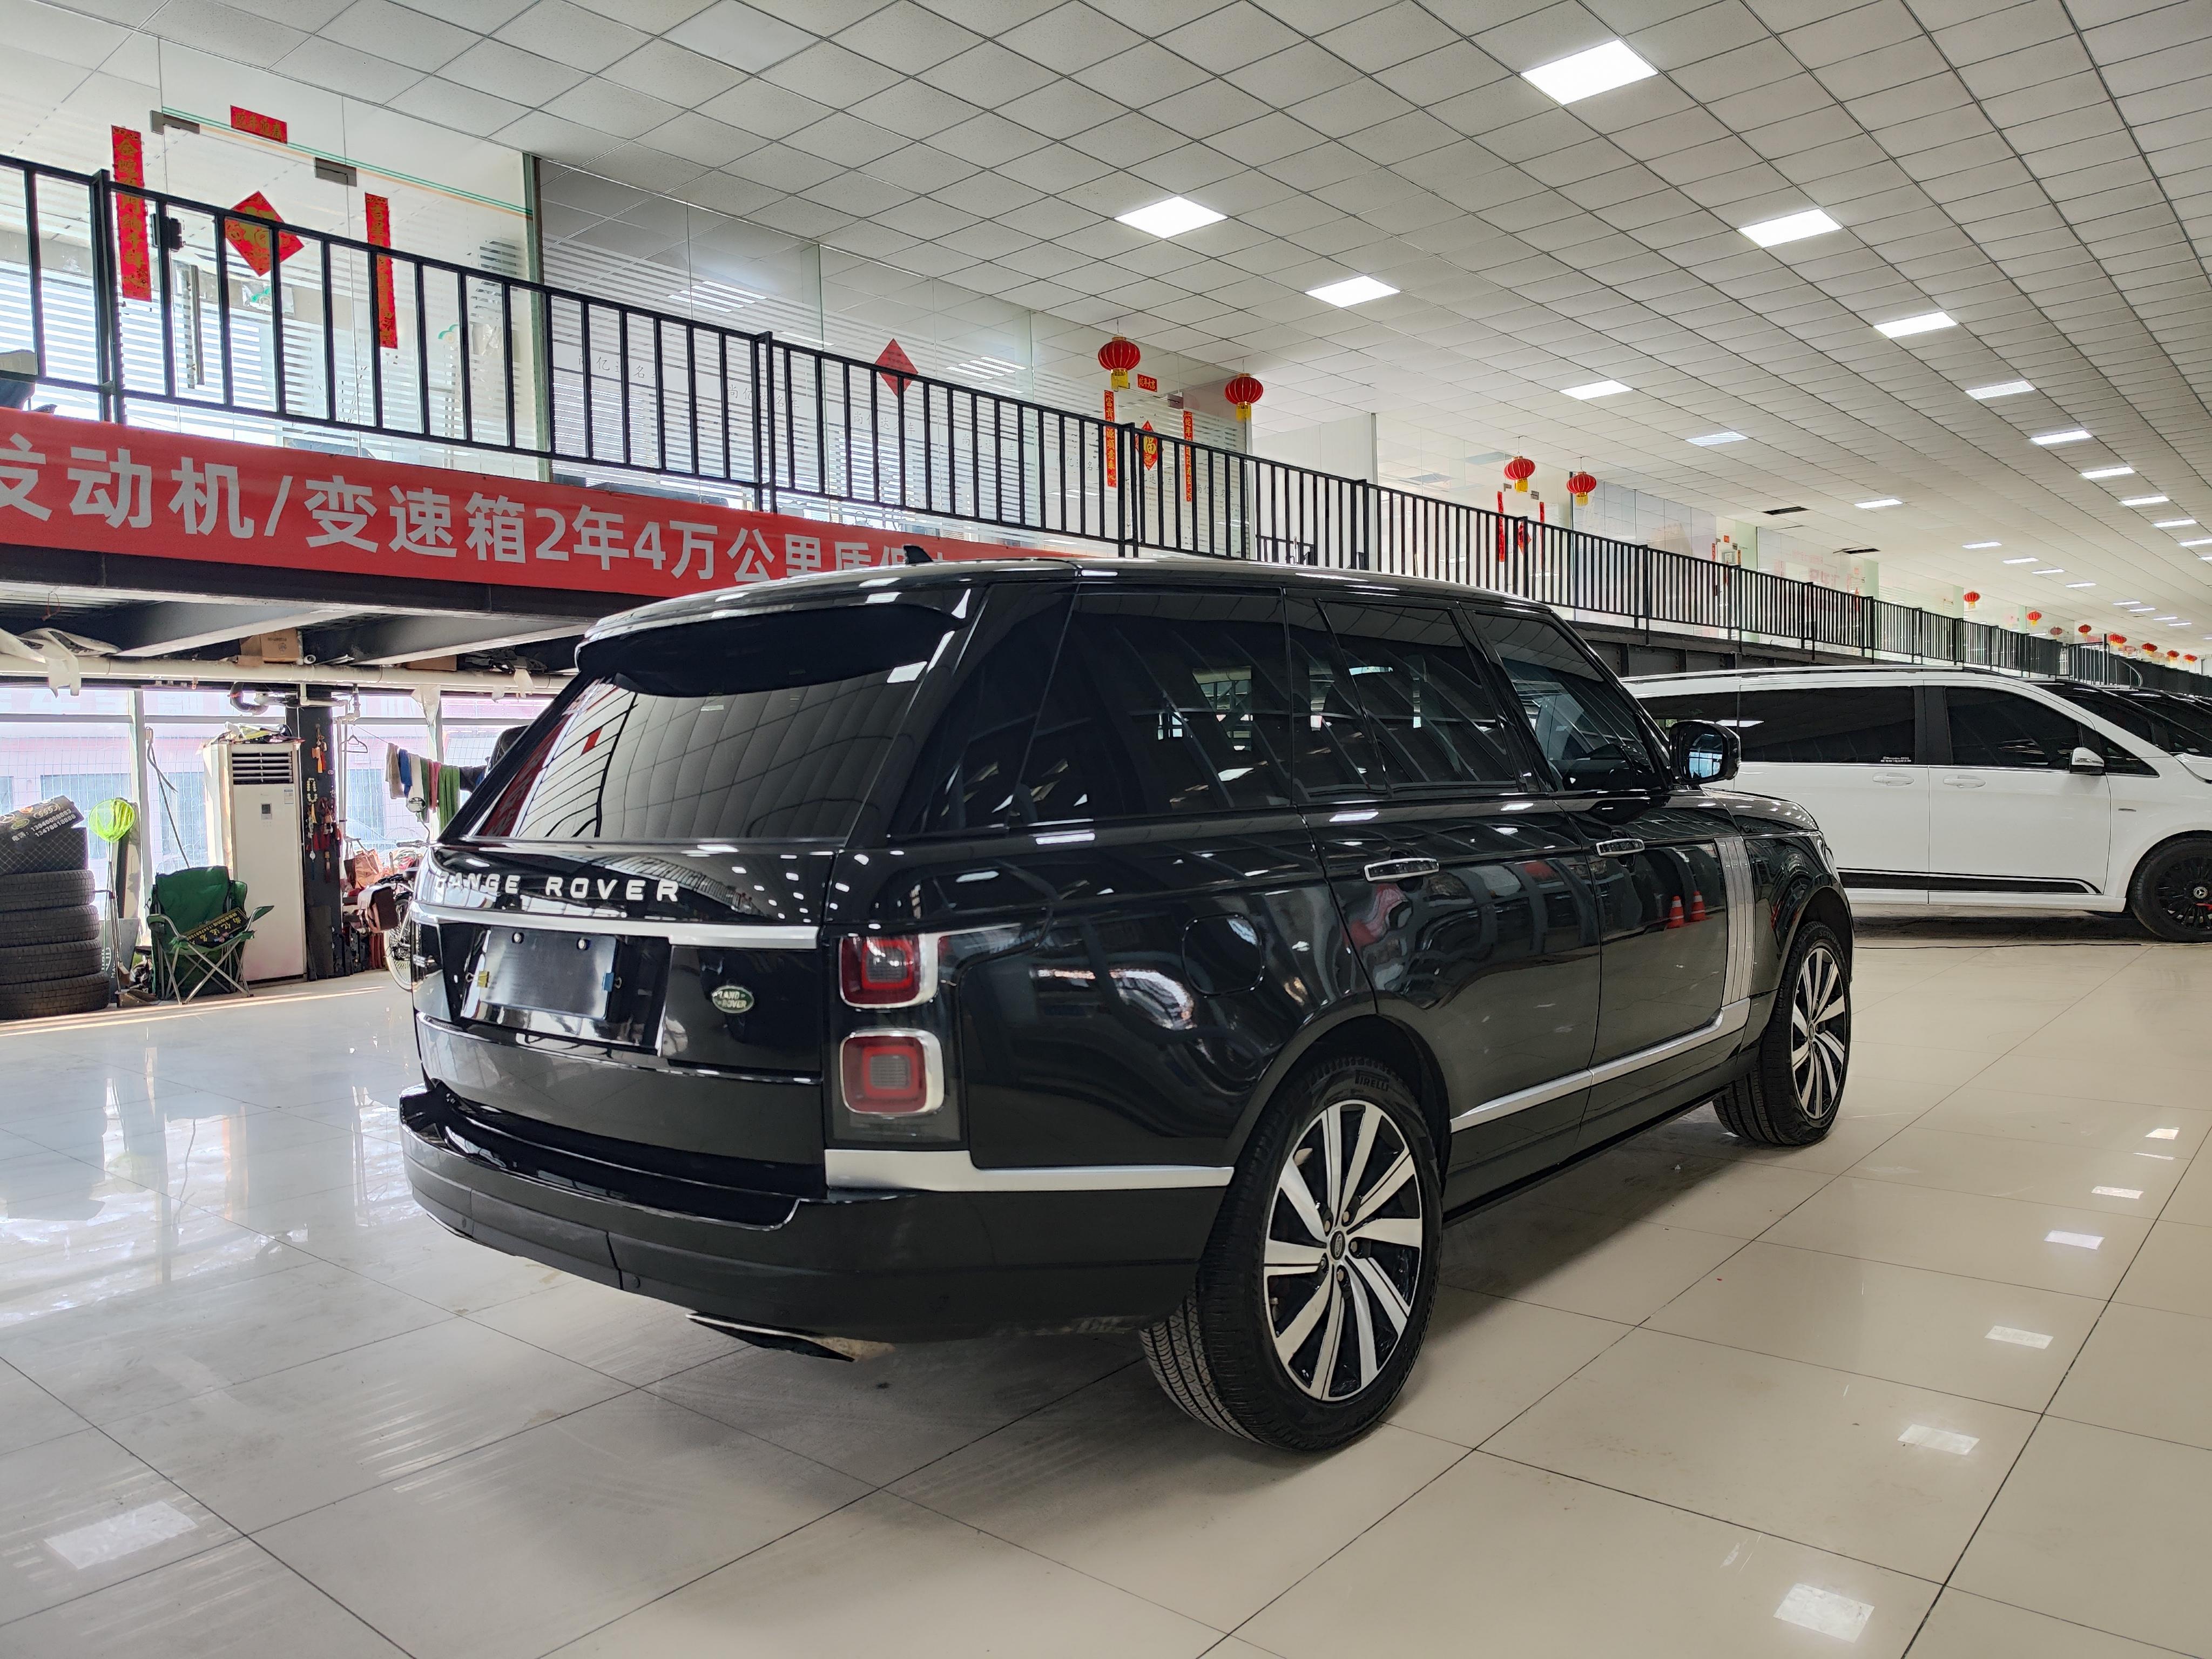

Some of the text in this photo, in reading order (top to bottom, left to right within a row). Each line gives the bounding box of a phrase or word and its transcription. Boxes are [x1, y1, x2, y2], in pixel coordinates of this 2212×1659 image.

[435, 872, 679, 902] RANGE ROVER
[719, 990, 740, 1000] LAND
[721, 999, 747, 1008] ROVER
[1355, 1069, 1389, 1091] PIRELLI
